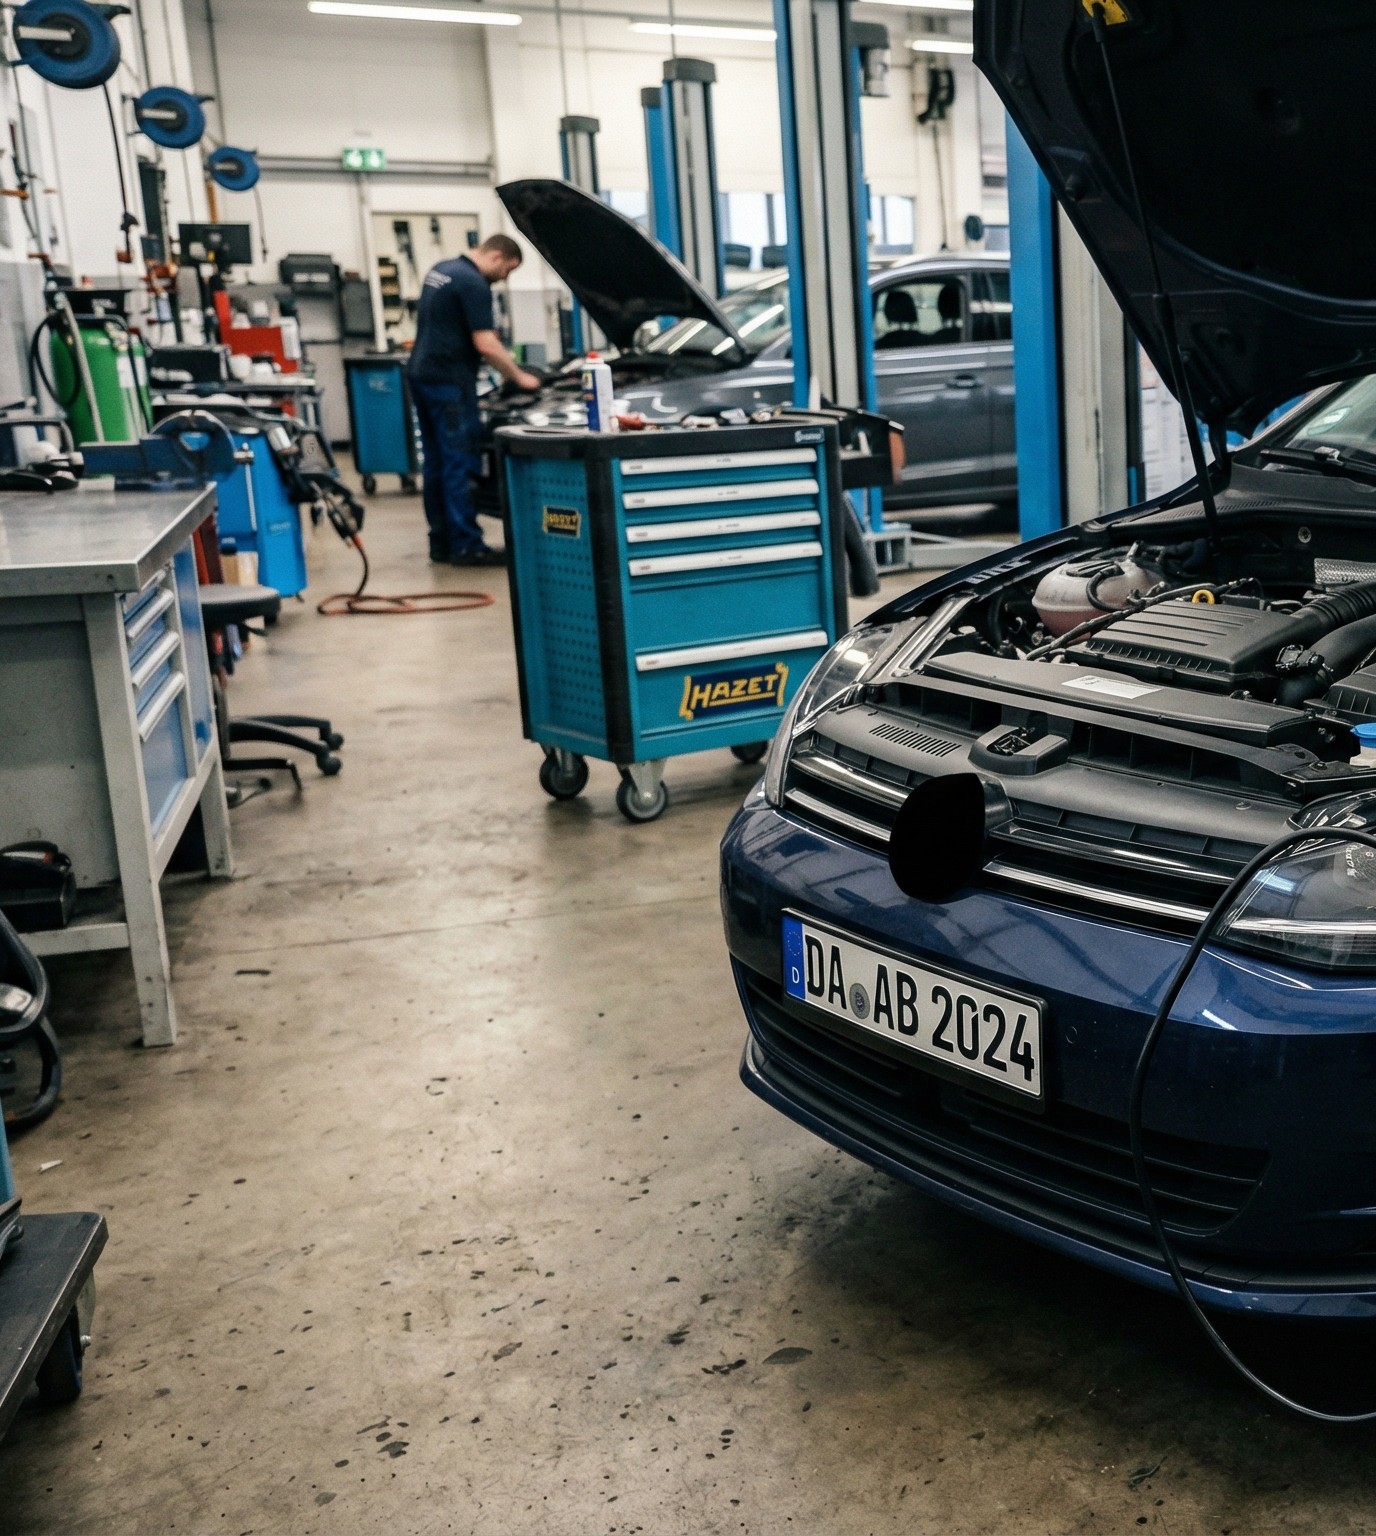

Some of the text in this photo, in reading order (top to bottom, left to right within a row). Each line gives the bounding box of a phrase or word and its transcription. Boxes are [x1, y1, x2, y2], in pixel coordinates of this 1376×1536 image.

[690, 673, 779, 710] HAZET
[791, 966, 800, 984] D
[805, 934, 1035, 1082] DA AB 2024
